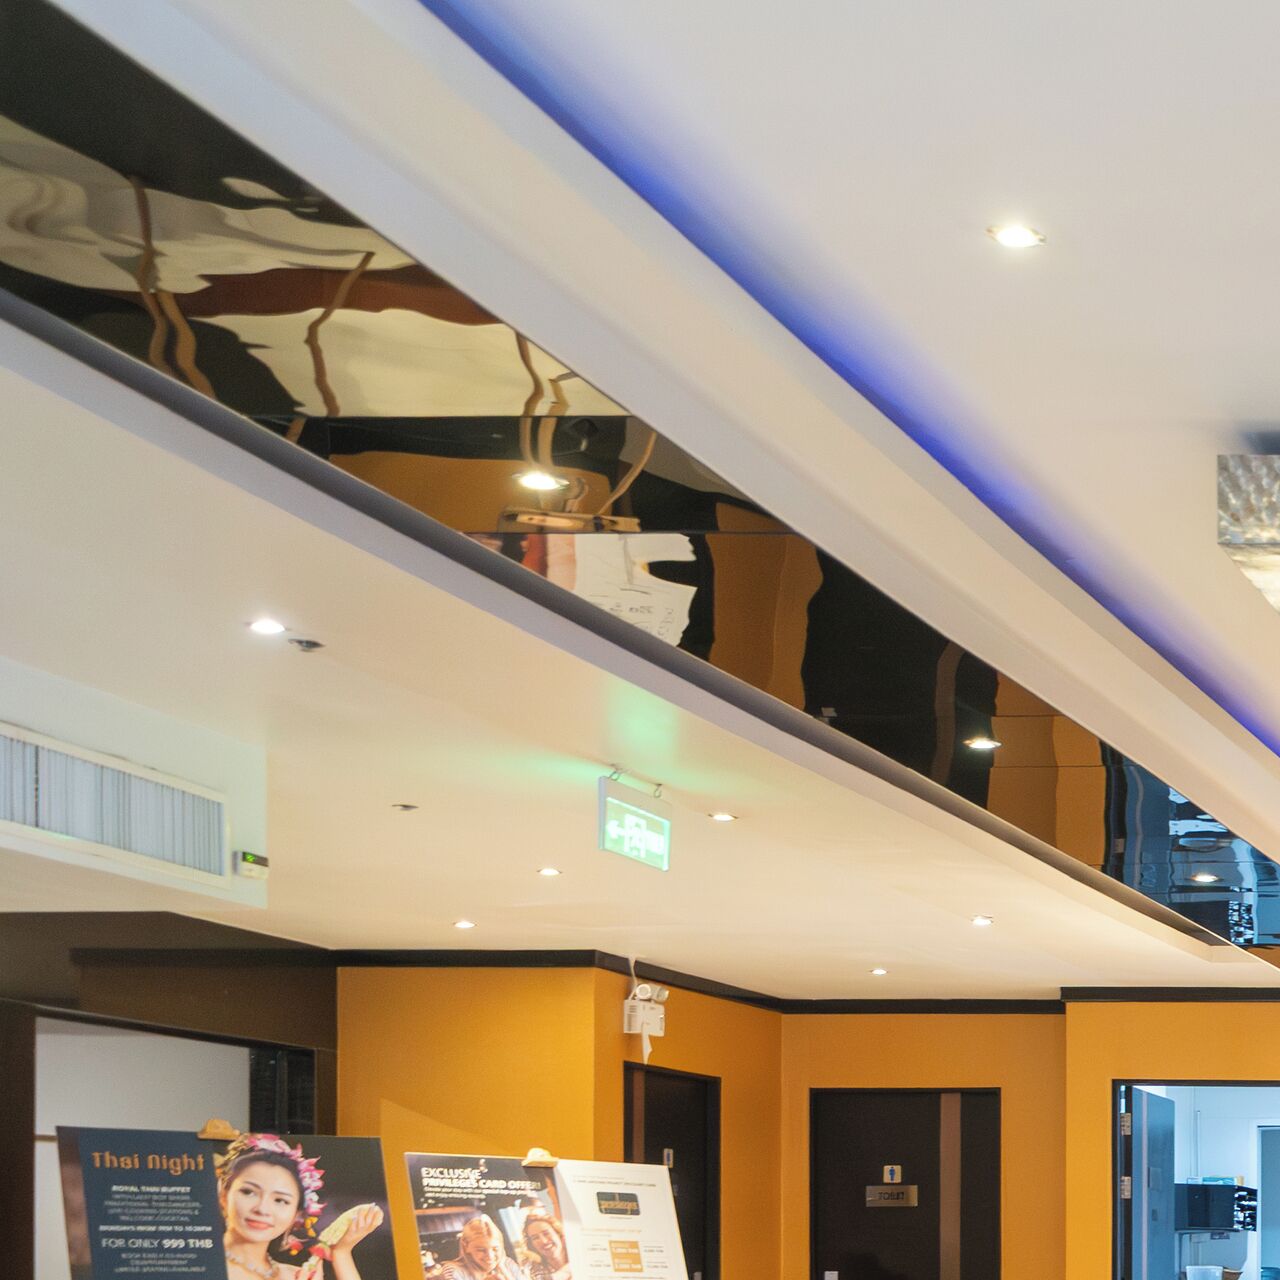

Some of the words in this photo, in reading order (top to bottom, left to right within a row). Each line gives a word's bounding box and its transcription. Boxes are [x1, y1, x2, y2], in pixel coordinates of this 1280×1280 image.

[91, 1151, 140, 1169] Thai
[147, 1153, 205, 1176] Night
[421, 1166, 482, 1179] EXCLUSIVE
[478, 1180, 507, 1189] CARD
[102, 1239, 126, 1248] FOR
[128, 1239, 160, 1249] ONLY
[161, 1239, 186, 1249] 999
[187, 1239, 214, 1249] THB
